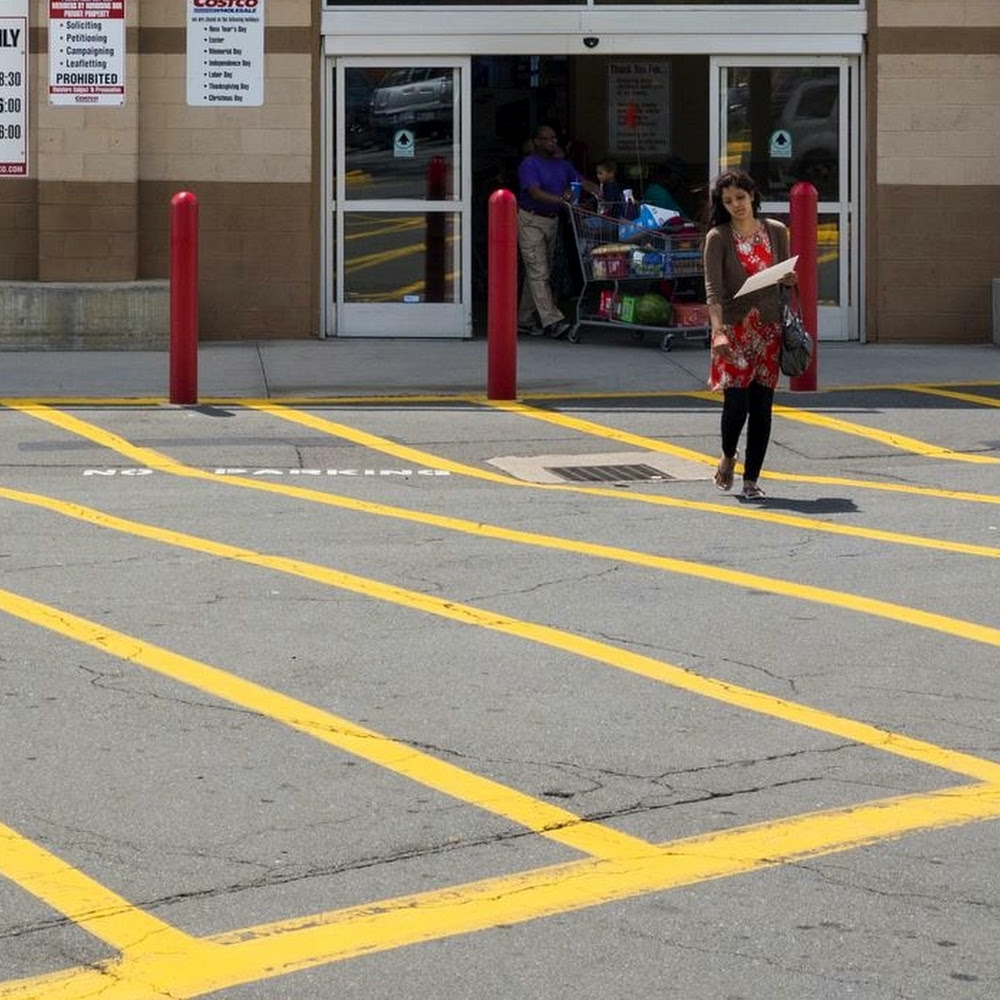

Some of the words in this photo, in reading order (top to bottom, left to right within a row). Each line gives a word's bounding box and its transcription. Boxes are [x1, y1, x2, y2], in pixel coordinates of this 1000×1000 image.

[66, 21, 102, 31] Soliciting
[66, 34, 107, 44] Petitioning
[66, 46, 114, 56] Campaigning
[66, 59, 107, 69] Leafletting
[242, 60, 251, 68] Day
[56, 73, 118, 84] PROHIBITED
[224, 71, 233, 79] Day
[209, 83, 240, 91] Thanksgiving
[240, 83, 250, 91] Day
[208, 94, 233, 102] Christmas
[234, 94, 243, 102] Day
[214, 468, 451, 476] PARKING
